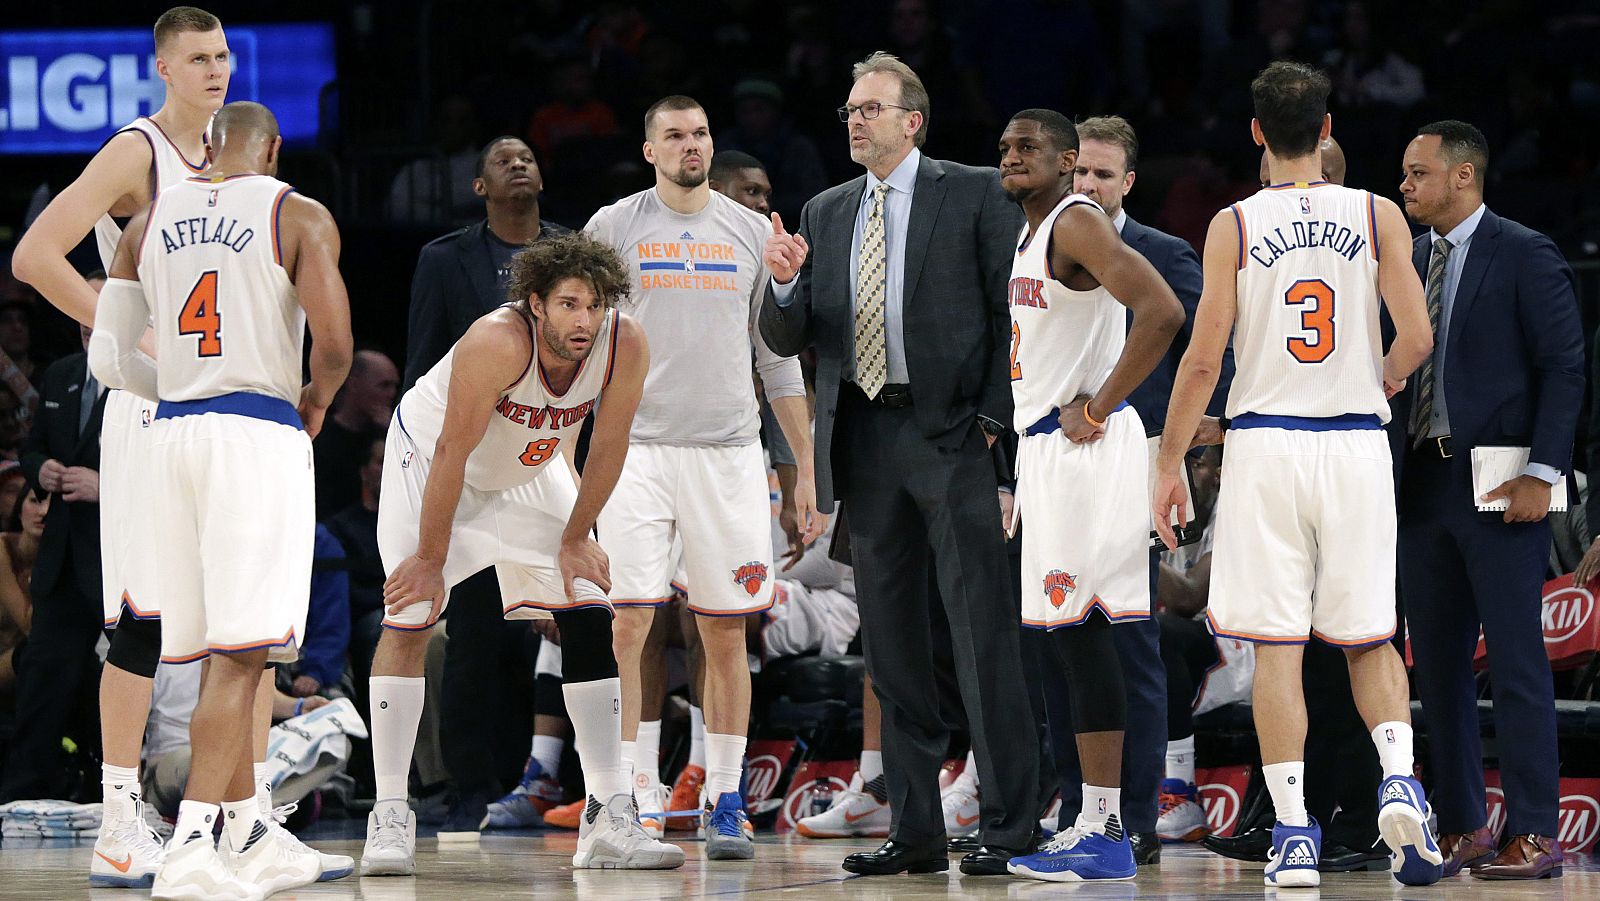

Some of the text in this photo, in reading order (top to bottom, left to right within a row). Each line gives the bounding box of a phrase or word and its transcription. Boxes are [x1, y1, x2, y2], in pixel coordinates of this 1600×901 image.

[0, 53, 237, 132] IGH
[161, 216, 254, 254] AFFLALO
[637, 243, 736, 260] NEW YORK
[1250, 221, 1366, 268] CALDERON
[640, 274, 738, 291] BASKETBALL
[178, 270, 222, 358] 4
[1285, 279, 1335, 363] 3
[1010, 320, 1023, 381] 2
[496, 394, 546, 430] NEW
[518, 437, 561, 467] 8
[1541, 598, 1582, 631] KIA
[1286, 856, 1315, 866] adidas
